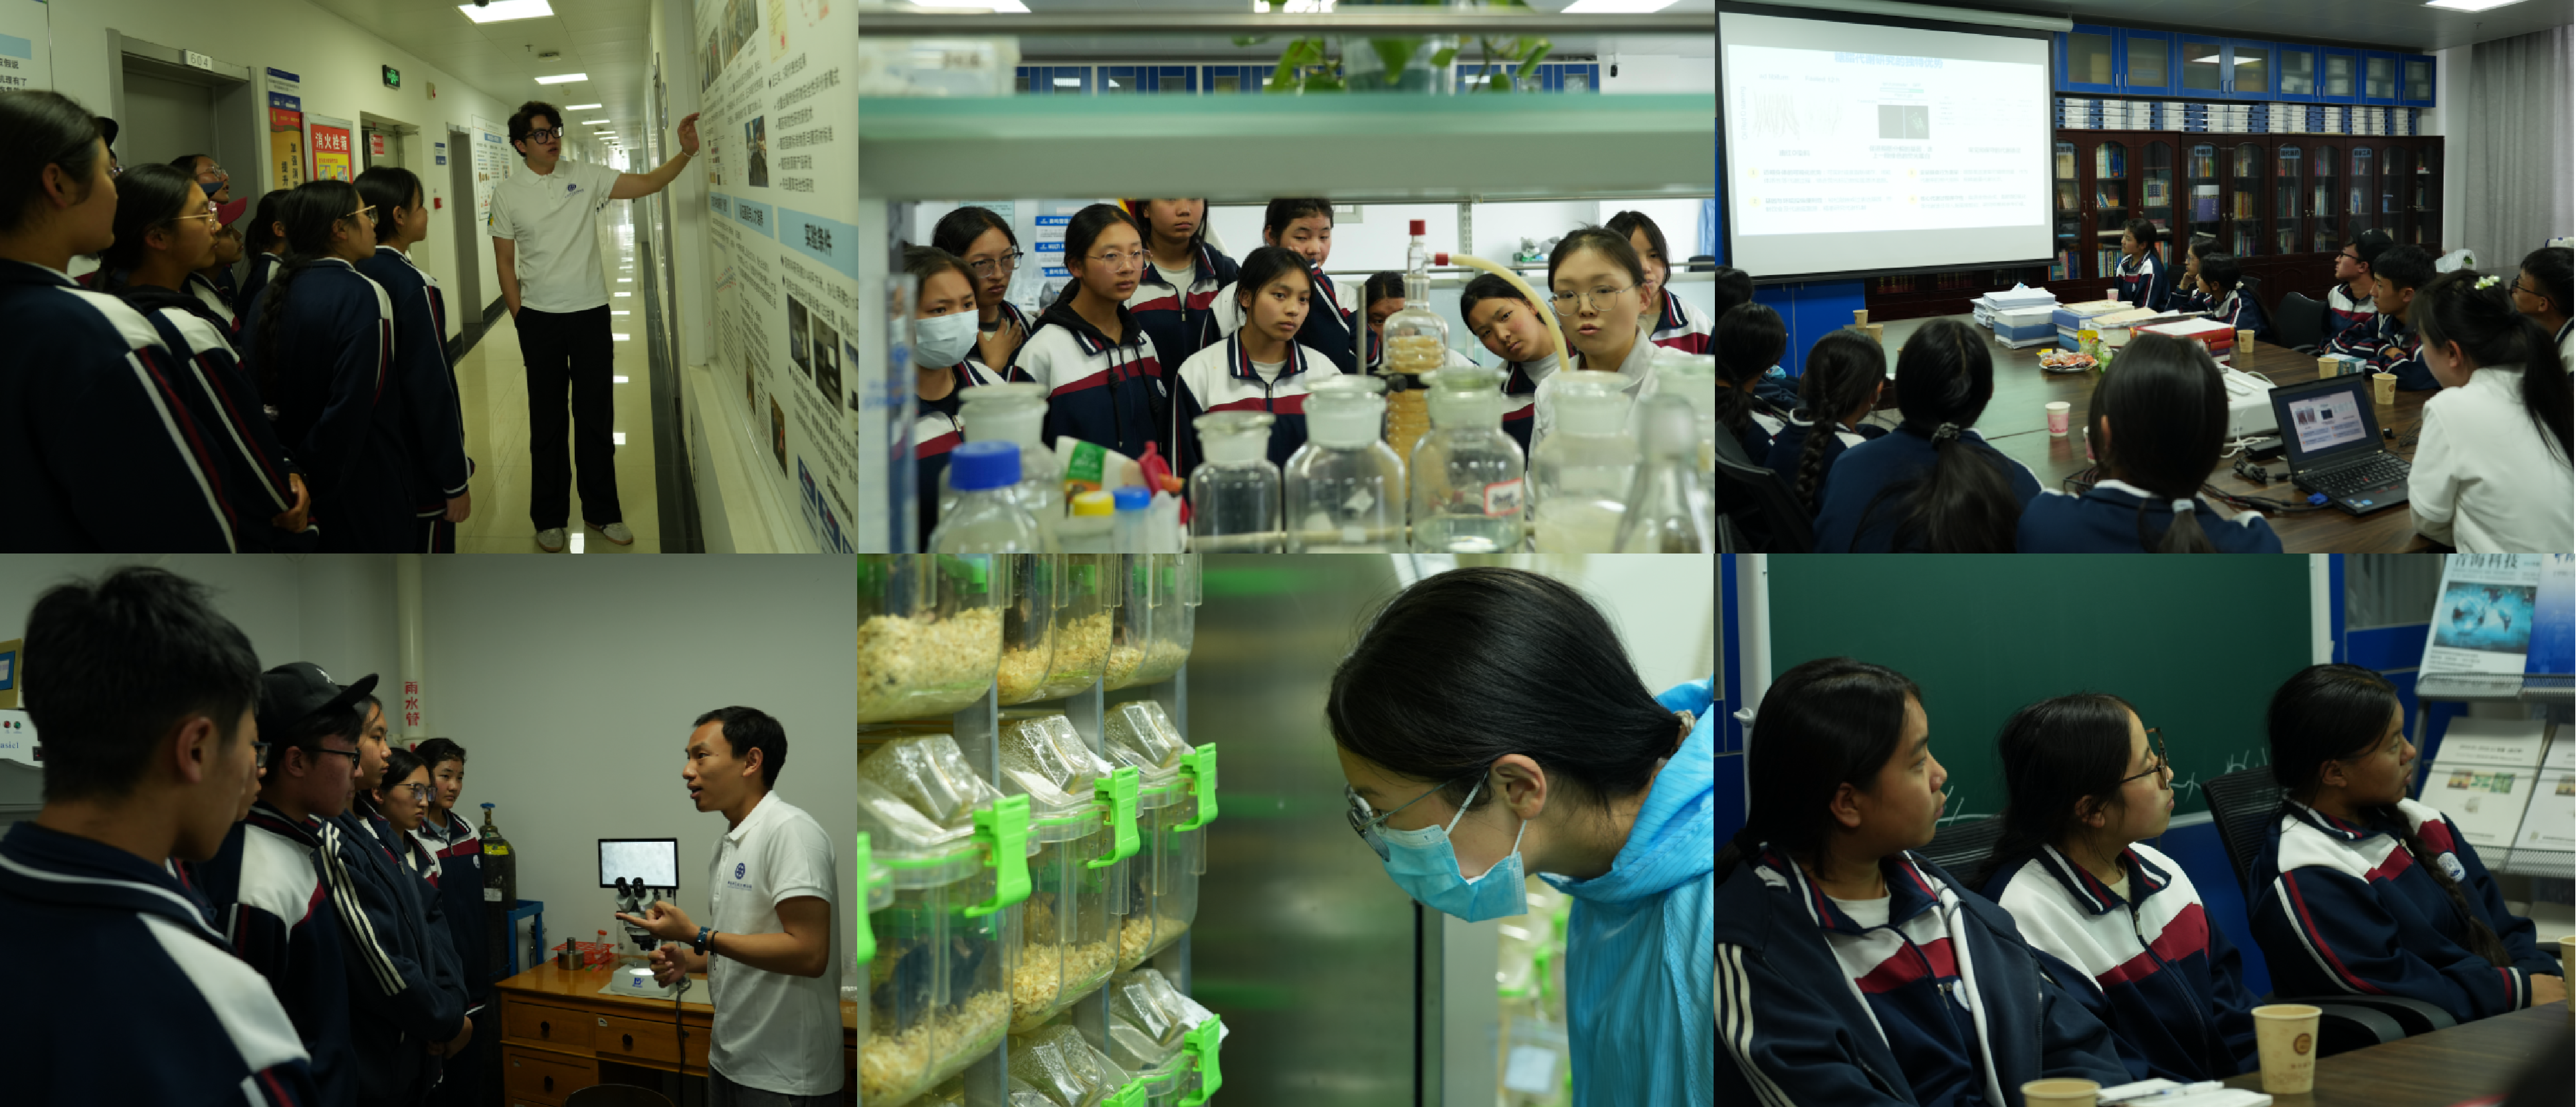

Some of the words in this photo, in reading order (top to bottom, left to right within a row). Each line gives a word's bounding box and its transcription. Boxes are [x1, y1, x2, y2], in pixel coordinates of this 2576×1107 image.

[190, 53, 209, 68] 604
[316, 132, 347, 150] 消火栓箱
[404, 681, 420, 727] 雨水管
